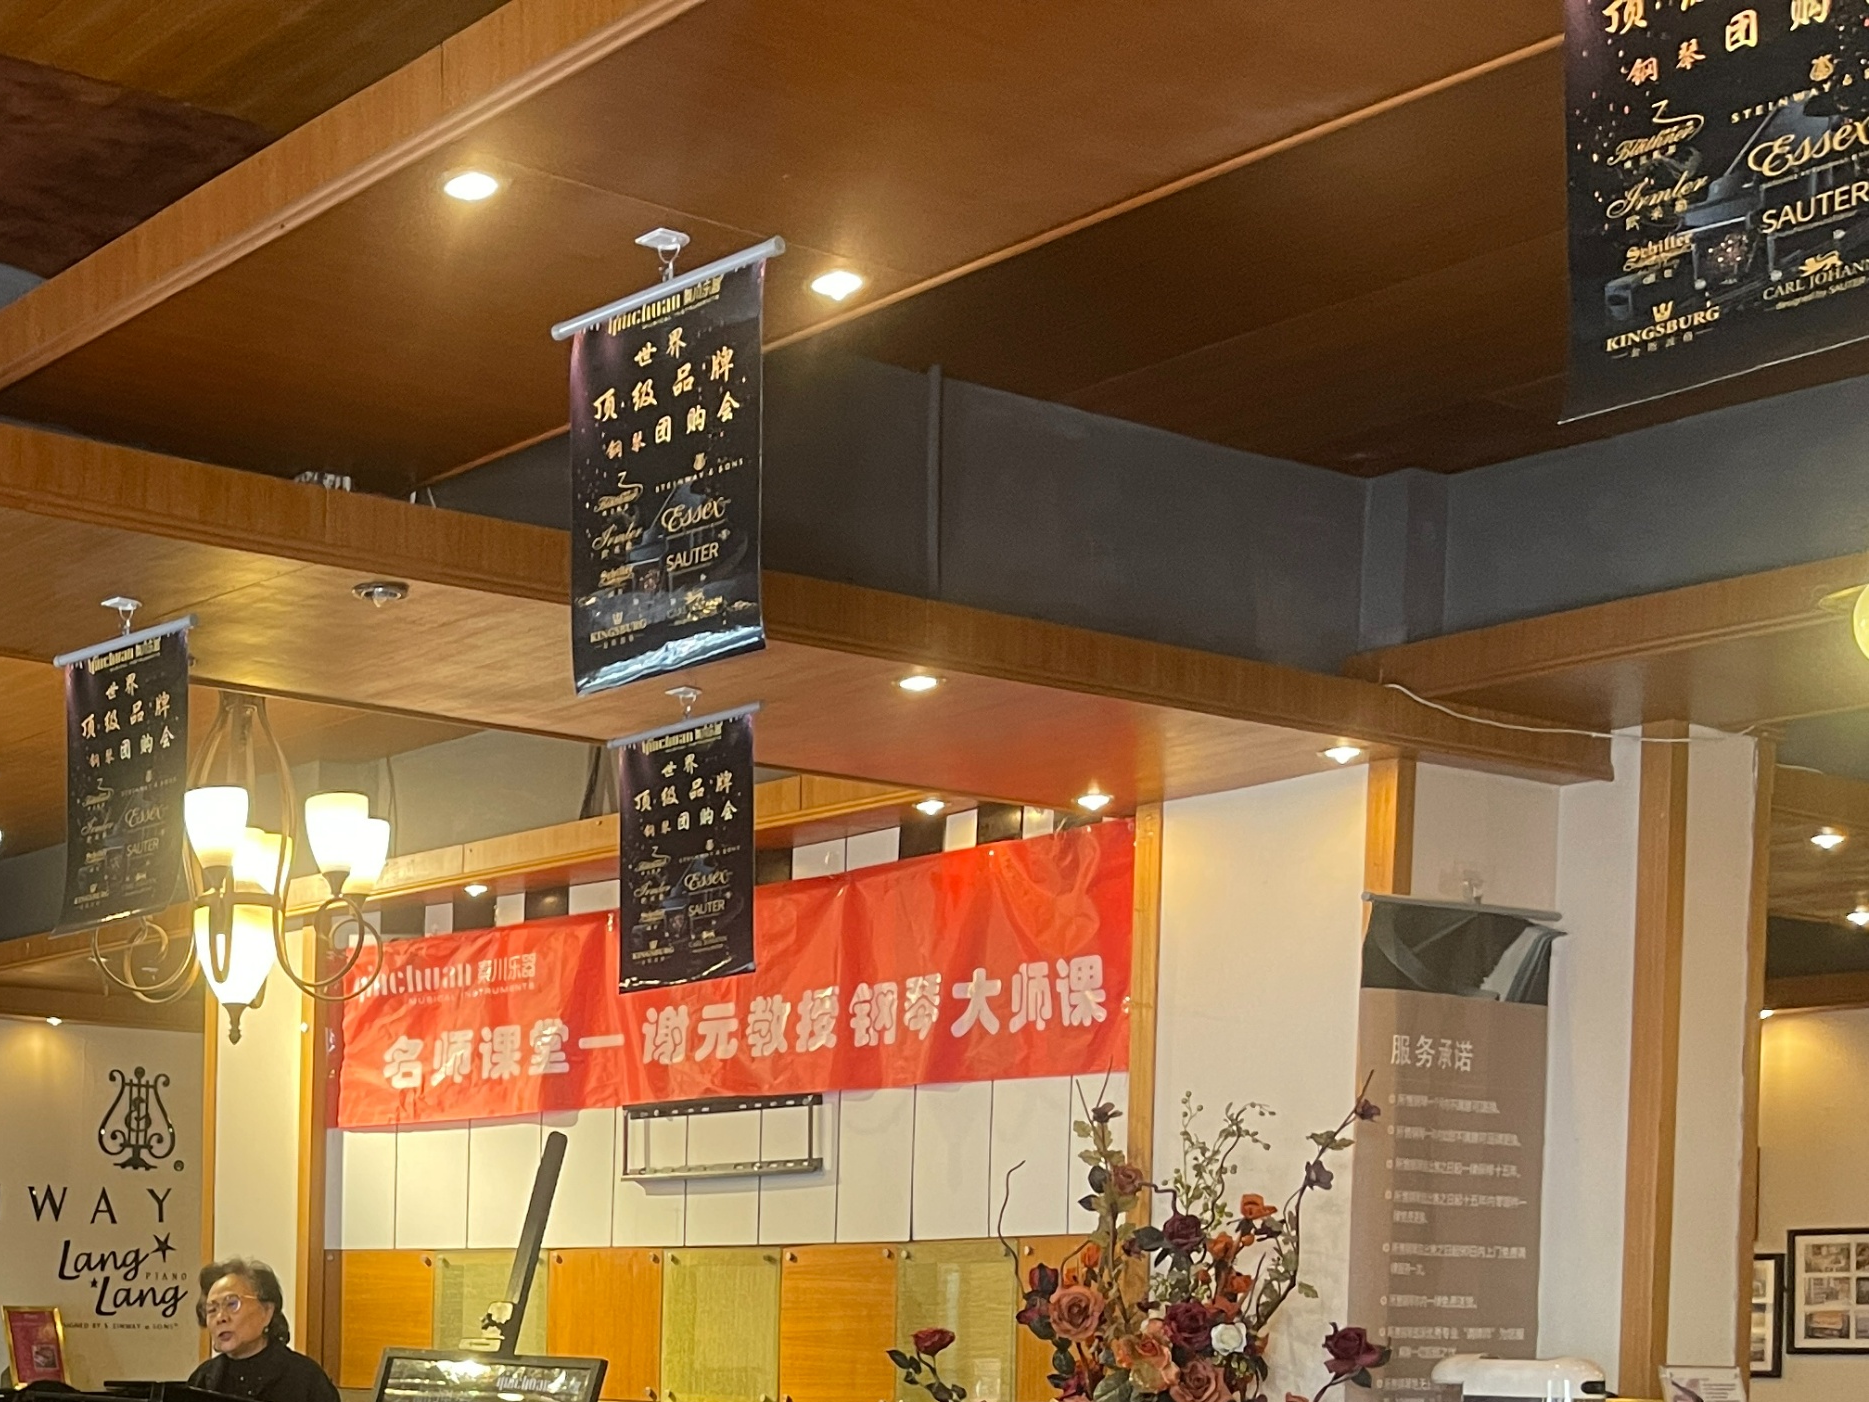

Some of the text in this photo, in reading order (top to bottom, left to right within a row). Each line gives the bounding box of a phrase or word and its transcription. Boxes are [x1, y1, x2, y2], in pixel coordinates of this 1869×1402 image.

[1730, 80, 1832, 124] STEINWAY
[1746, 115, 1869, 178] Essex
[1761, 181, 1869, 234] SAUTER
[1762, 279, 1806, 301] CARL
[633, 326, 688, 368] 世界
[1605, 305, 1721, 352] KINGSBURG
[592, 345, 735, 423] 顶级品牌
[660, 495, 732, 533] Essex
[666, 541, 720, 572] SAUTER
[634, 770, 733, 813] 顶级品牌
[126, 837, 160, 858] SAUTER
[688, 899, 726, 918] SAUTER
[1390, 1034, 1474, 1073] 服务承诺
[58, 1239, 150, 1281] Lang
[145, 1271, 188, 1281] PIANO
[95, 1276, 189, 1318] Lang
